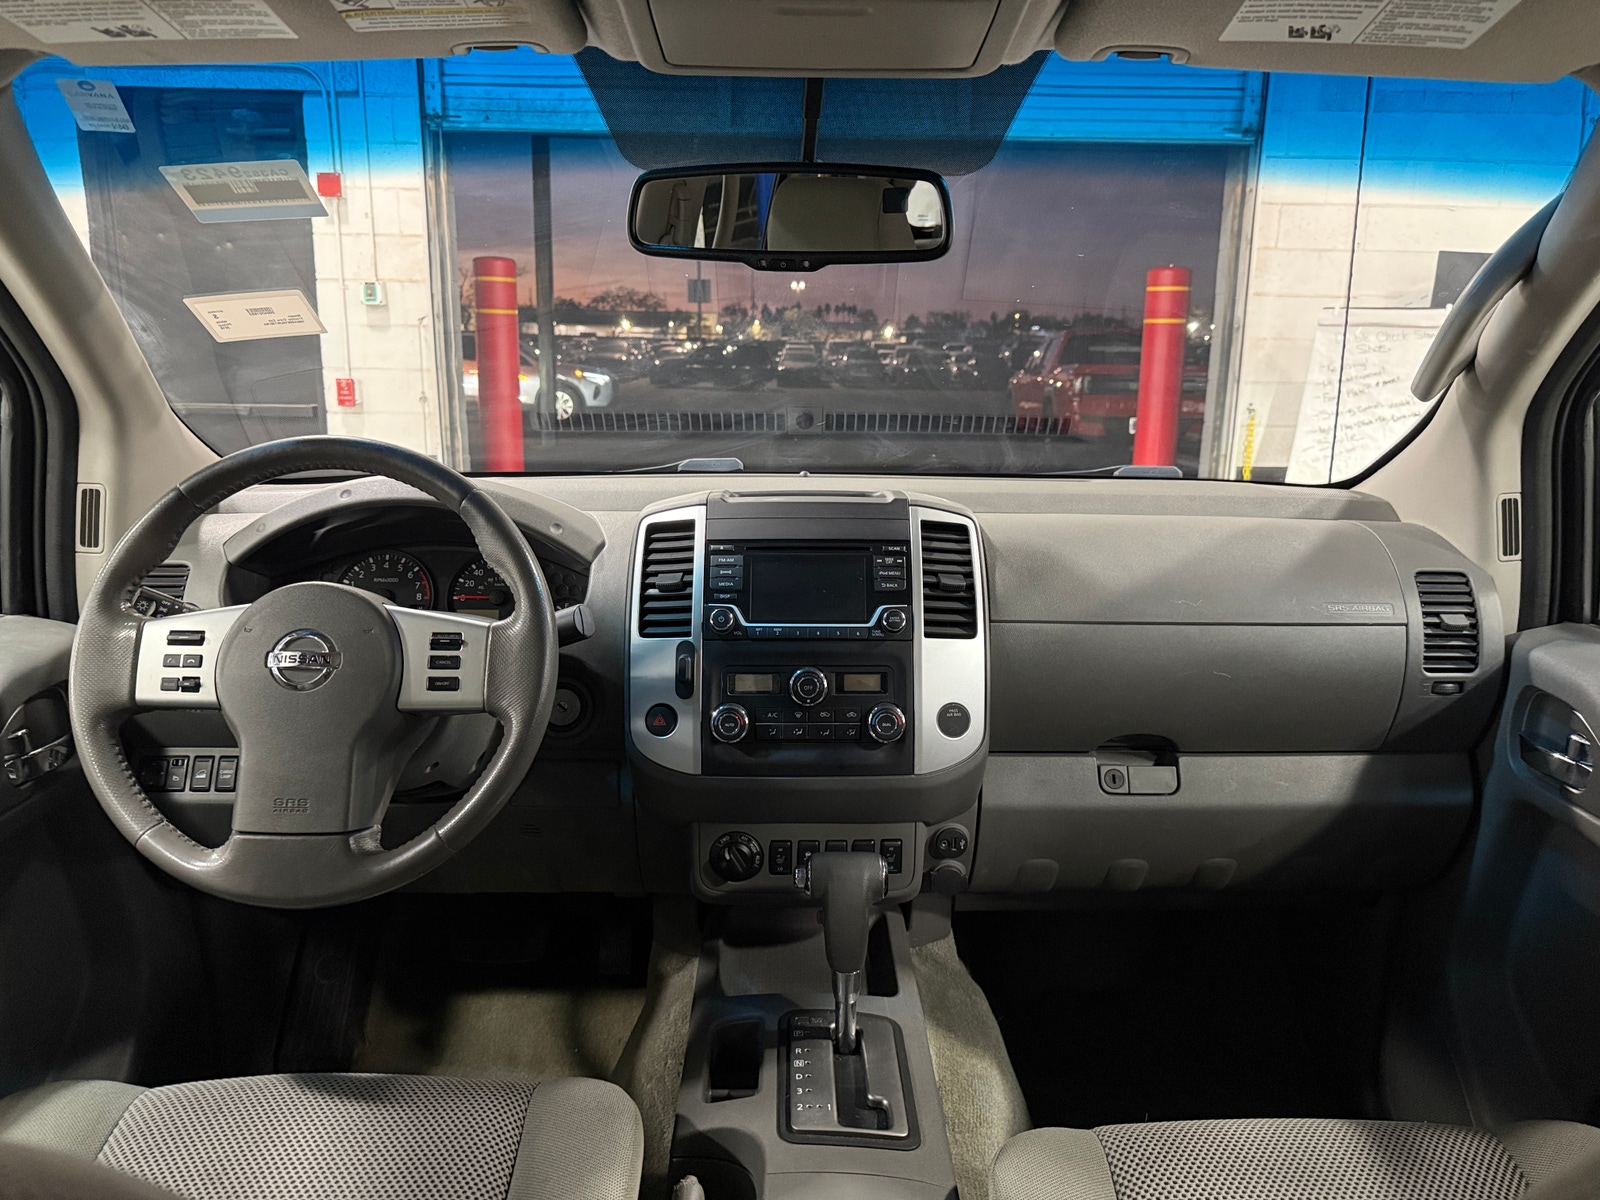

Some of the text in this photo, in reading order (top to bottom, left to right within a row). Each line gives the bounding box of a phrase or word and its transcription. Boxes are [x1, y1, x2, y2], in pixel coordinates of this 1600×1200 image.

[407, 571, 413, 579] 6
[1351, 604, 1390, 612] AIRBAG
[274, 654, 332, 665] NISSAN
[273, 797, 310, 807] SRS
[796, 1087, 803, 1095] 3
[796, 1103, 831, 1111] 2 1
